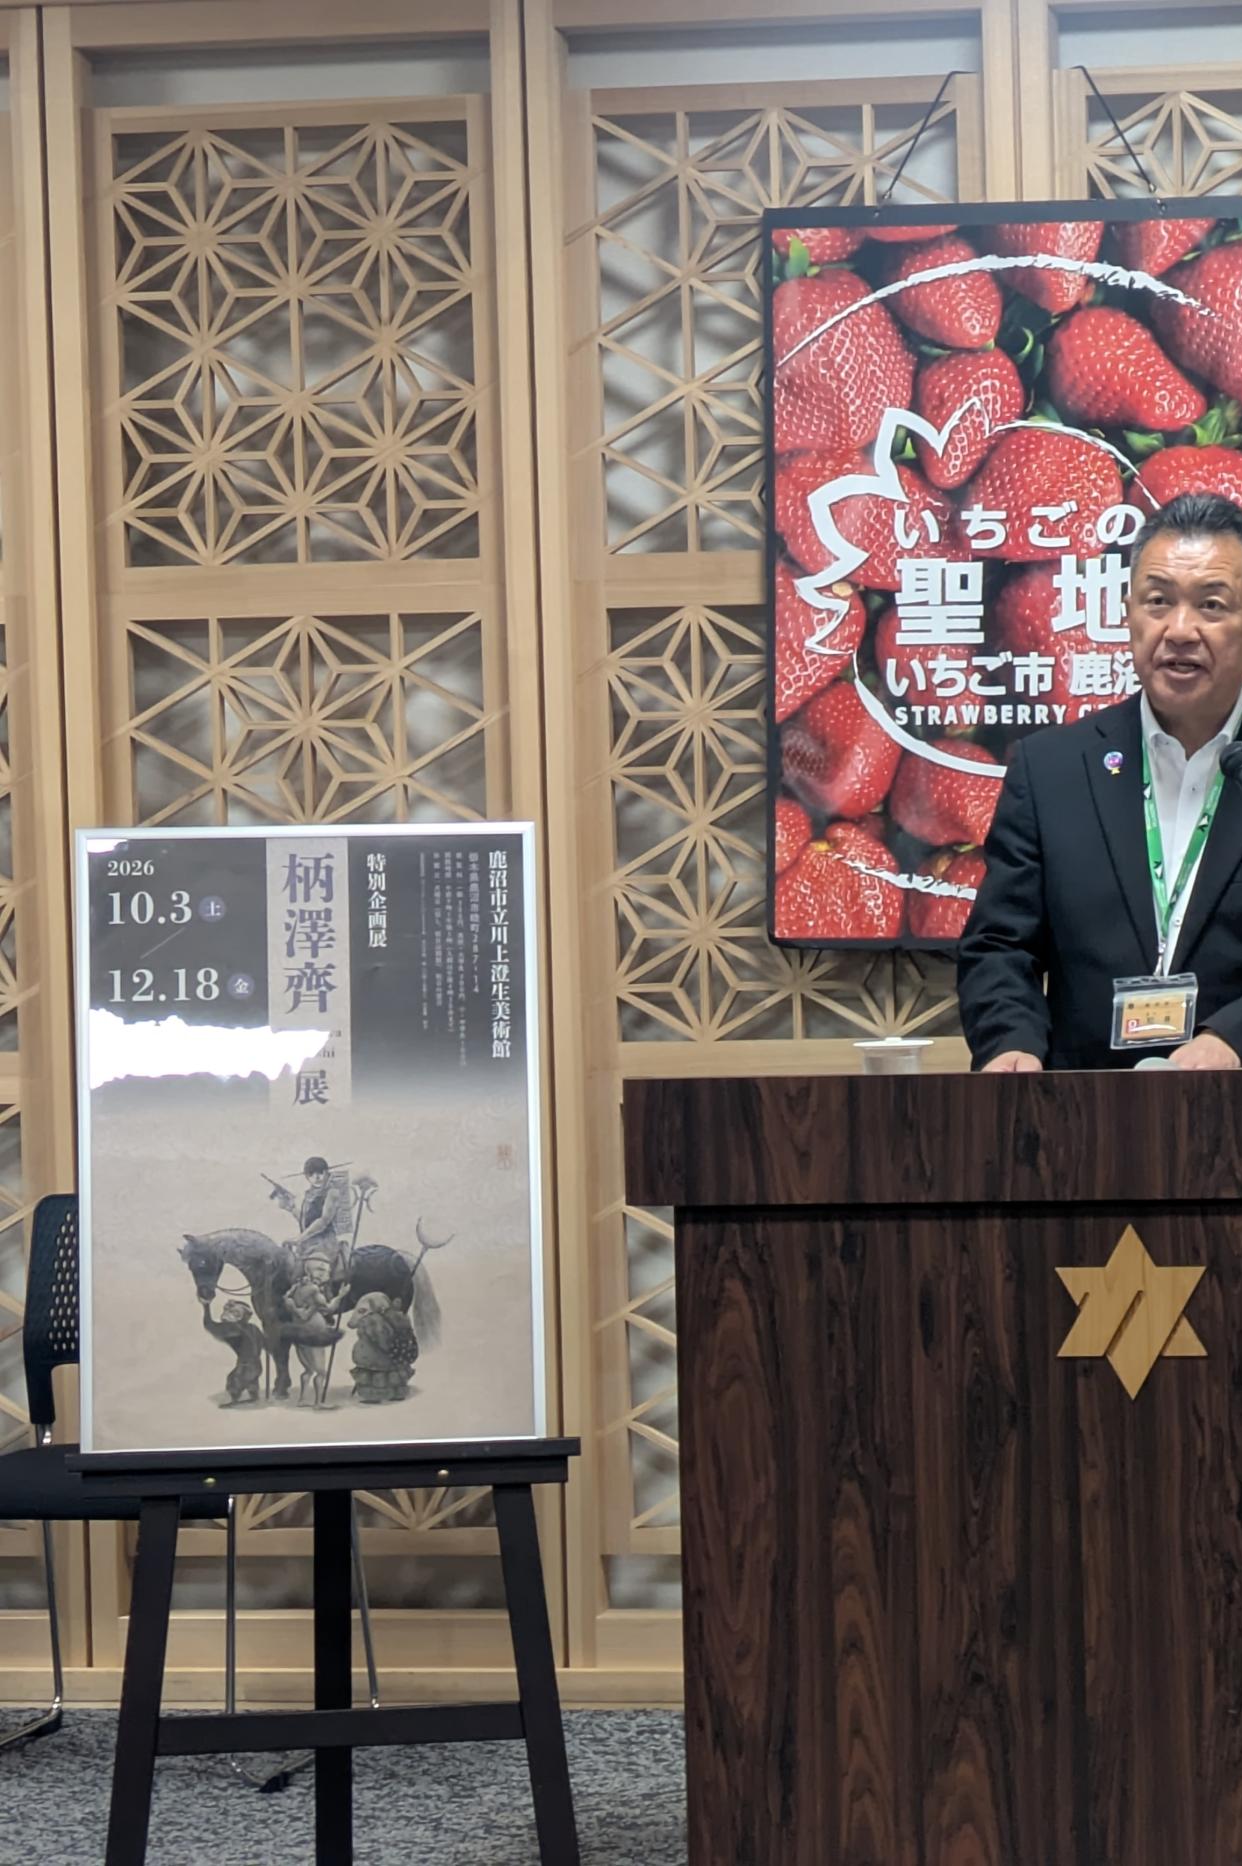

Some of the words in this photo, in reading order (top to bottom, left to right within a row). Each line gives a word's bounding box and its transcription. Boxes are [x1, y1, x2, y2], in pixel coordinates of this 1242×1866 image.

[893, 500, 1146, 549] いちごの
[895, 553, 1131, 645] 聖地
[886, 652, 1056, 697] いちご市
[895, 704, 1067, 726] STRAWBERRY
[107, 860, 154, 876] 2026
[108, 891, 192, 925] 10.3
[206, 901, 221, 916] 土
[367, 853, 387, 948] 特別企画展
[488, 849, 511, 1058] 鹿沼市立川上澄生美術館
[108, 968, 220, 1002] 12.18
[234, 978, 249, 993] 金
[292, 1069, 329, 1105] 展
